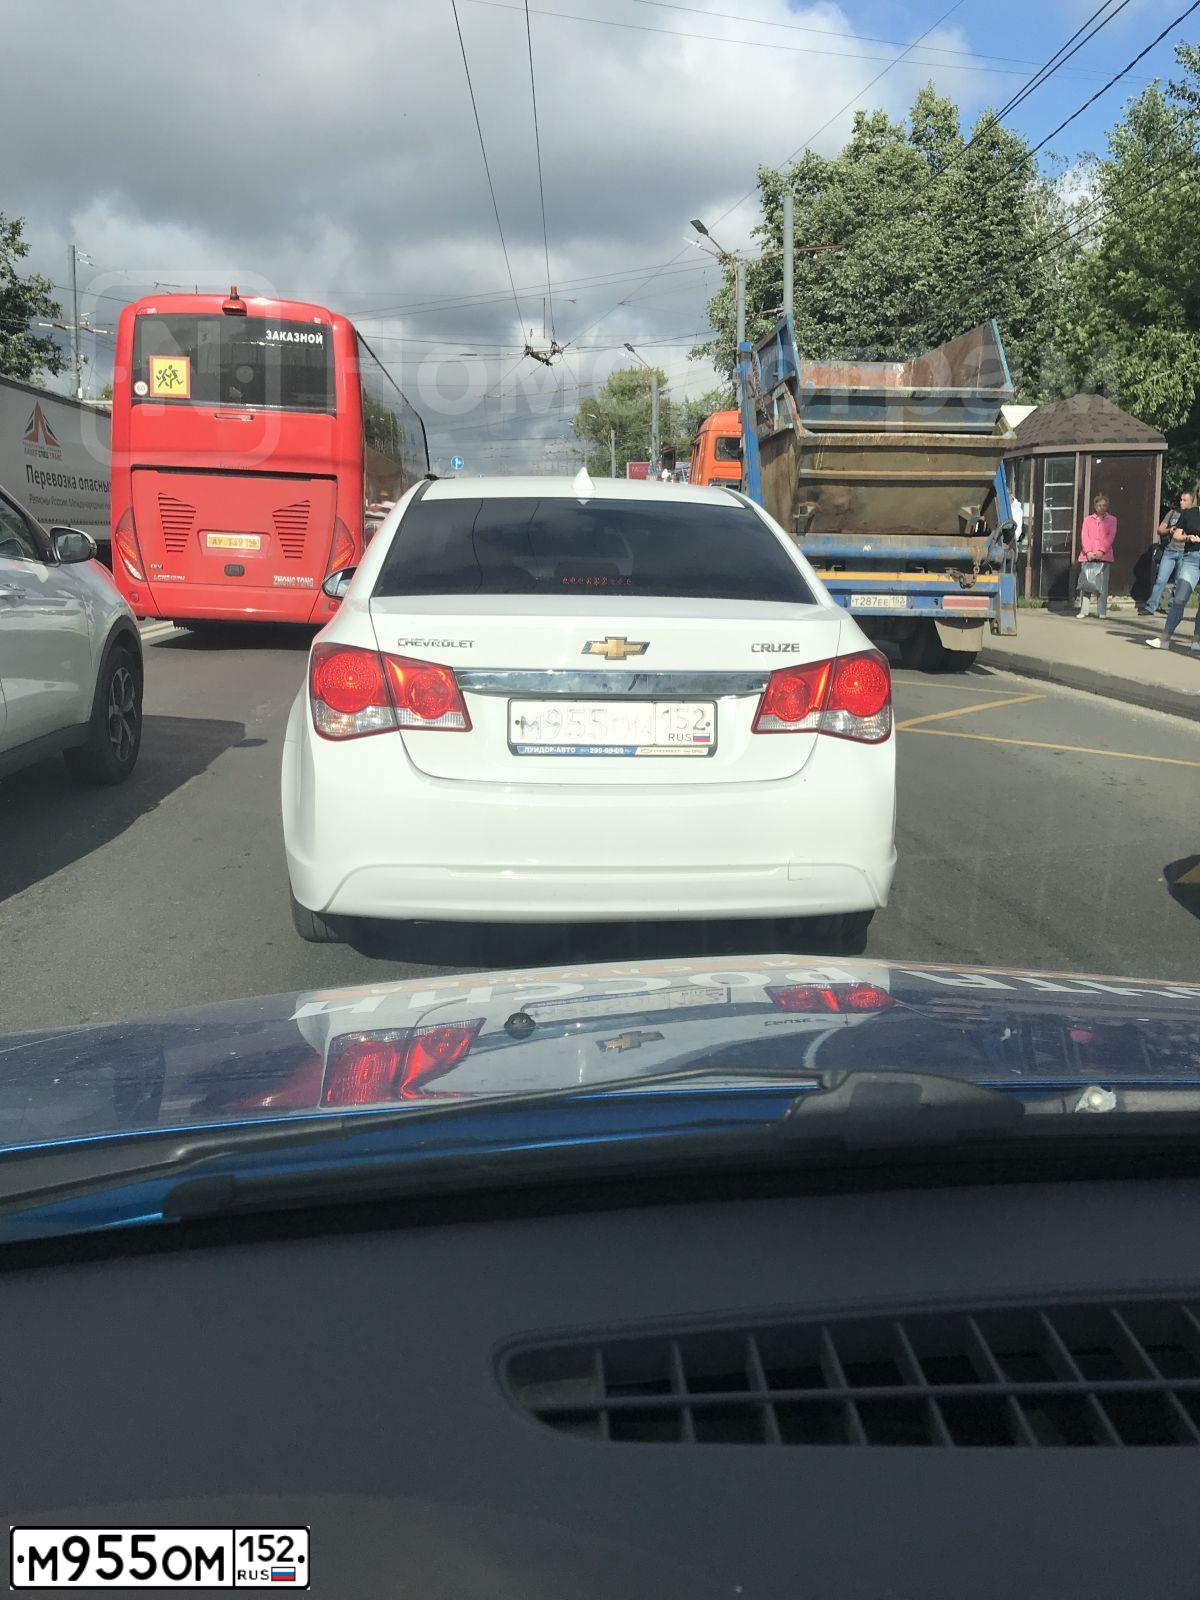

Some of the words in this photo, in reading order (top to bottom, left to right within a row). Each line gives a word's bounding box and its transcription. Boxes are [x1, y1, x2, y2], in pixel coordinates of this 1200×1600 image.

[266, 330, 324, 345] ЗАКАЗНОЙ
[25, 464, 77, 489] Перевозка
[79, 477, 111, 493] опасны
[398, 638, 475, 648] CHEVROLET
[751, 643, 800, 652] CRUZE
[668, 732, 691, 742] RUS
[288, 967, 858, 1020] РОССИИ
